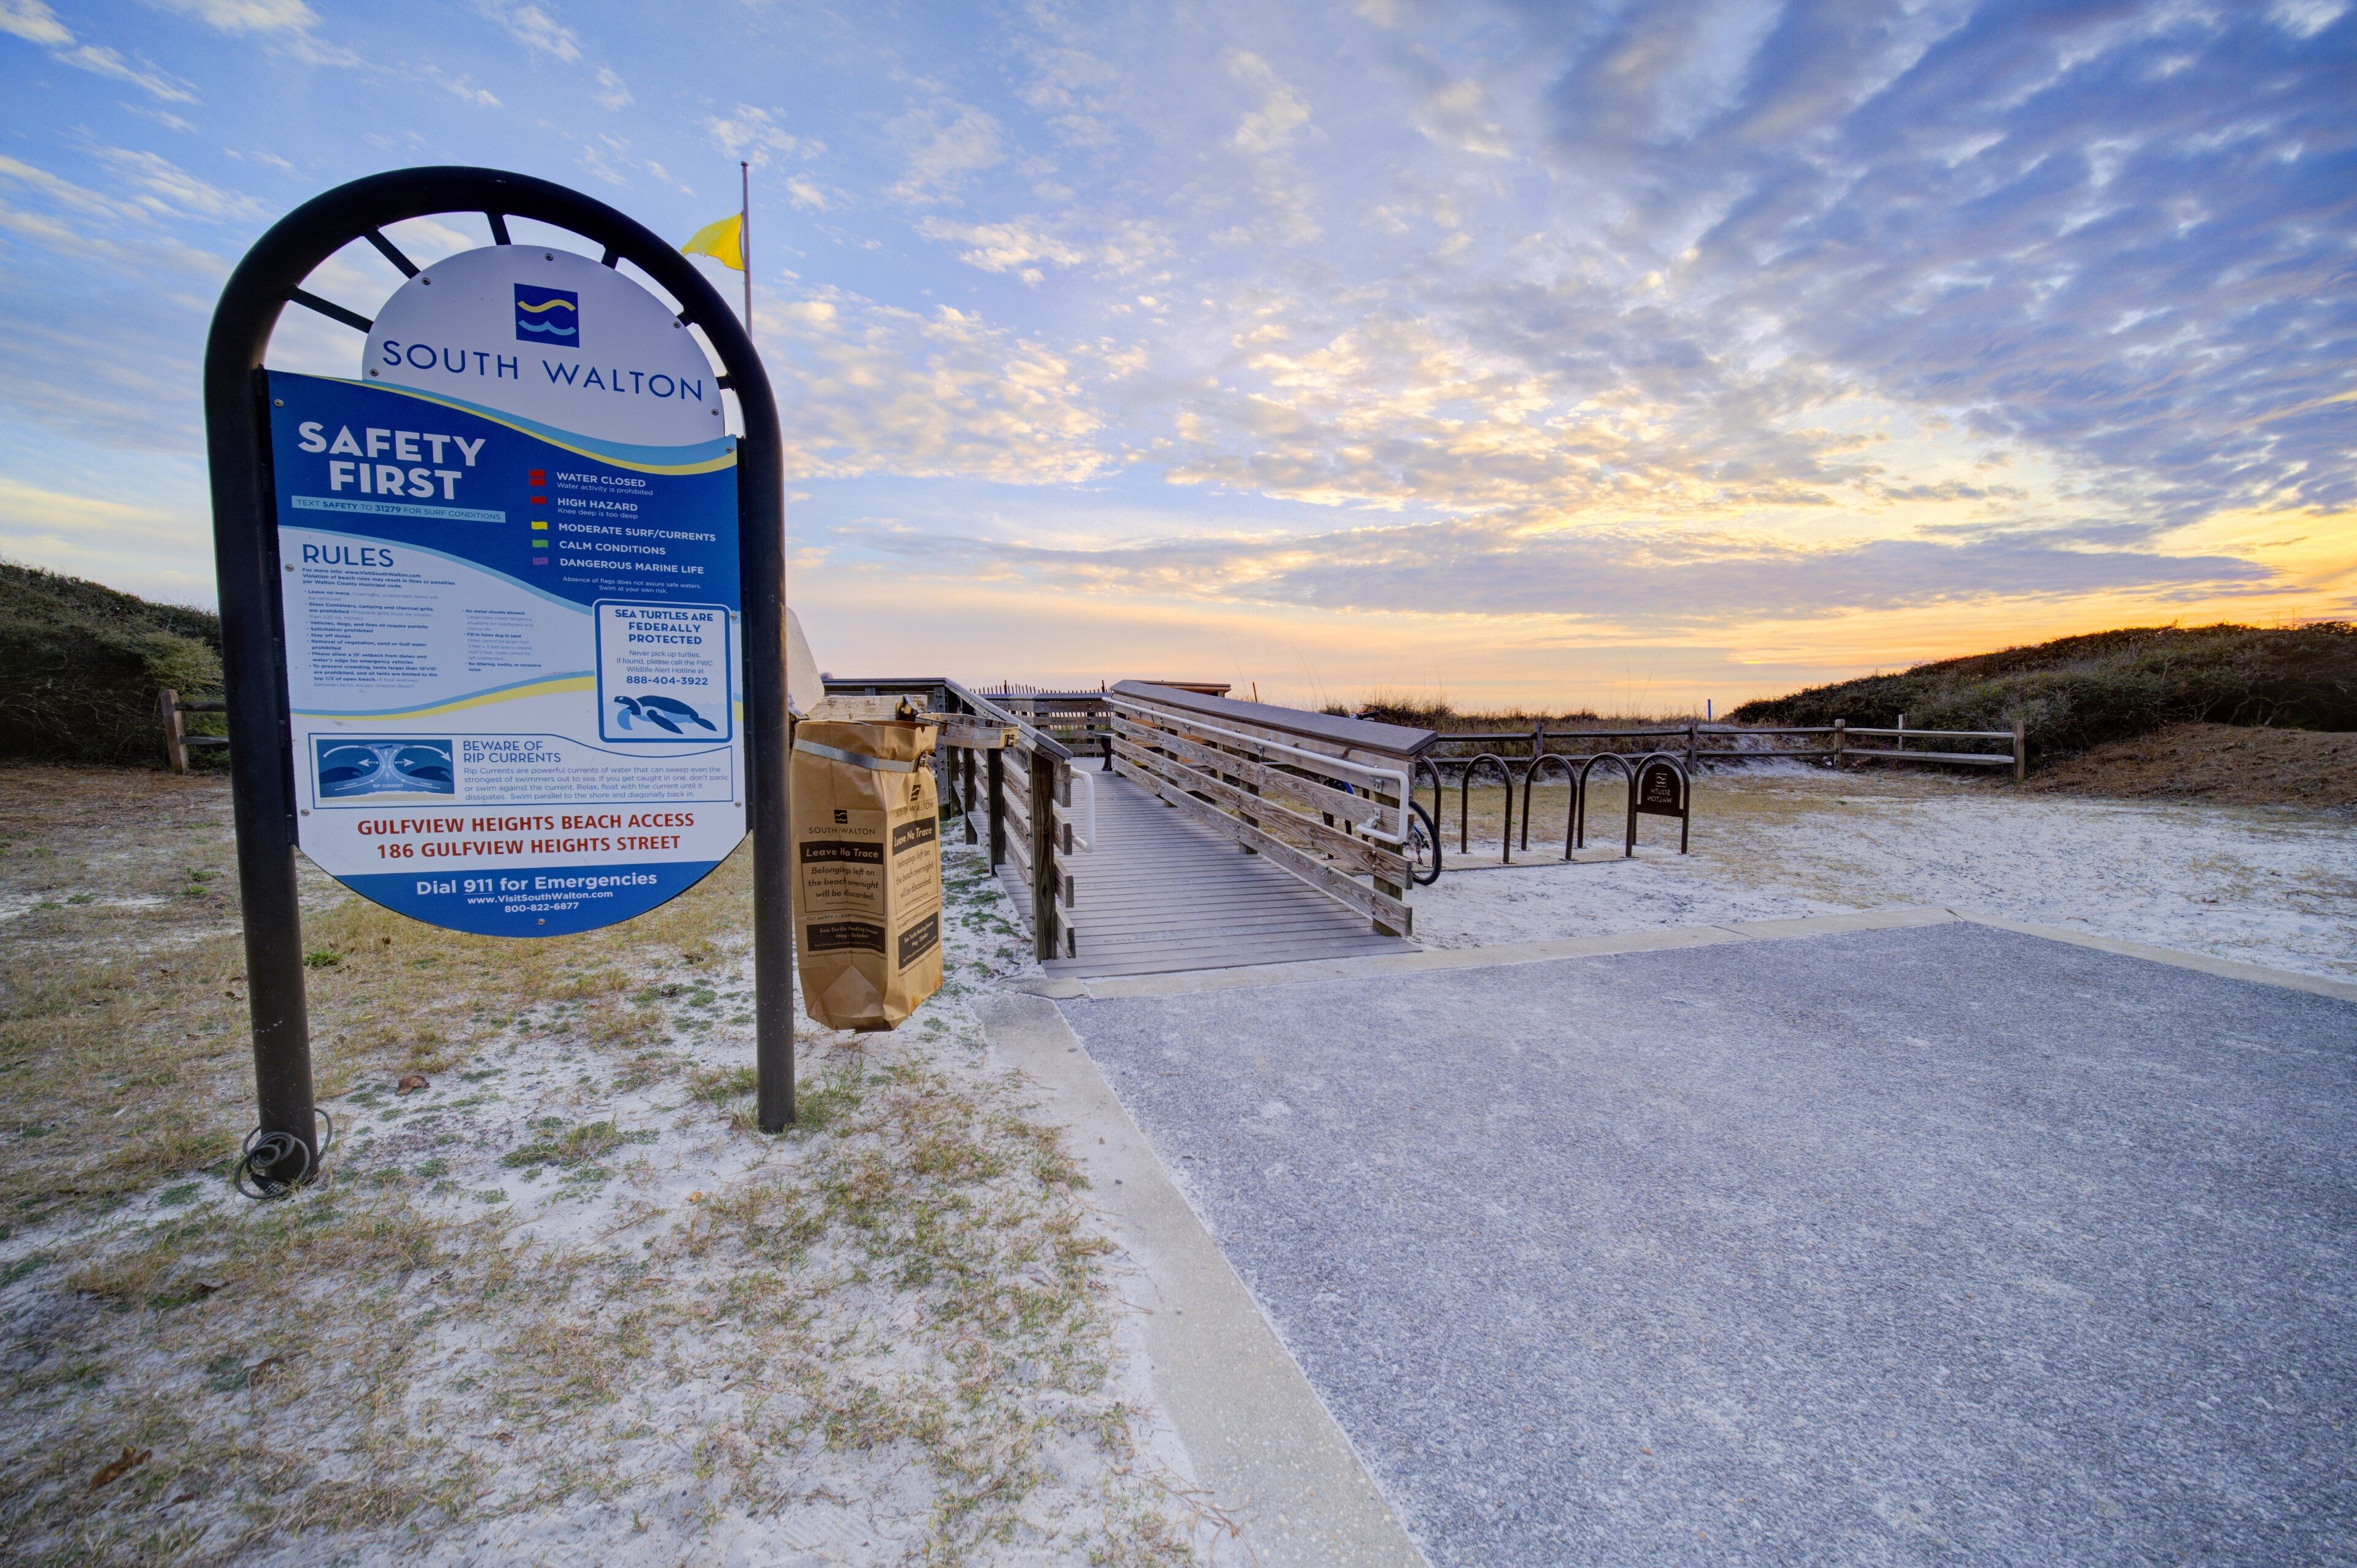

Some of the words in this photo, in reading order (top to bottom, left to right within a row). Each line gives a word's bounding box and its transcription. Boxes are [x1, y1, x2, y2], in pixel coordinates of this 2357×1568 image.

[382, 340, 518, 379] SOUTH
[542, 360, 702, 402] WALTON
[297, 421, 486, 466] SAFETY
[329, 460, 462, 500] FIRST
[556, 473, 597, 483] WATER
[601, 476, 646, 487] CLOSED
[557, 498, 586, 507] HIGH
[590, 501, 638, 511] HAZARD
[449, 511, 501, 520] CONDITIONS
[559, 523, 622, 535] MODERATE
[625, 528, 716, 541] SURF/CURRENTS
[559, 541, 592, 550] CALM
[595, 544, 665, 555] CONDITIONS
[302, 544, 394, 568] RULES
[560, 558, 632, 570] DANGEROUS
[635, 563, 678, 572] MARINE
[615, 609, 637, 618] SEA
[639, 610, 688, 620] TURTLES
[629, 622, 701, 632] FEDERALLY
[629, 634, 702, 644] PROTECTED
[627, 676, 708, 685] 888-404-3922
[463, 741, 520, 751] BEWARE
[524, 741, 543, 751] OF
[463, 753, 484, 762] RIP
[489, 753, 561, 762] CURRENTS
[358, 819, 464, 835] GULFVIEW
[472, 816, 554, 832] HEIGHTS
[562, 815, 621, 829] BEACH
[628, 813, 694, 827] ACCESS
[894, 835, 906, 848] Leave
[907, 831, 915, 841] No
[916, 827, 932, 838] Trace
[377, 844, 414, 859] 186
[421, 841, 523, 857] GULFVIEW
[531, 838, 610, 853] HEIGHTS
[617, 836, 680, 850] STREET
[806, 848, 837, 857] Leave
[853, 849, 878, 858] Trace
[811, 866, 851, 875] Belongings
[853, 867, 864, 876] left
[417, 880, 456, 894] Dial
[463, 879, 492, 892] 911
[500, 878, 528, 890] for
[535, 873, 657, 889] Emergencies
[848, 881, 878, 889] overnight
[467, 892, 613, 903] www.VisitSouthWalton.com
[844, 890, 875, 900] discarded.
[505, 902, 579, 913] 800-822-6877
